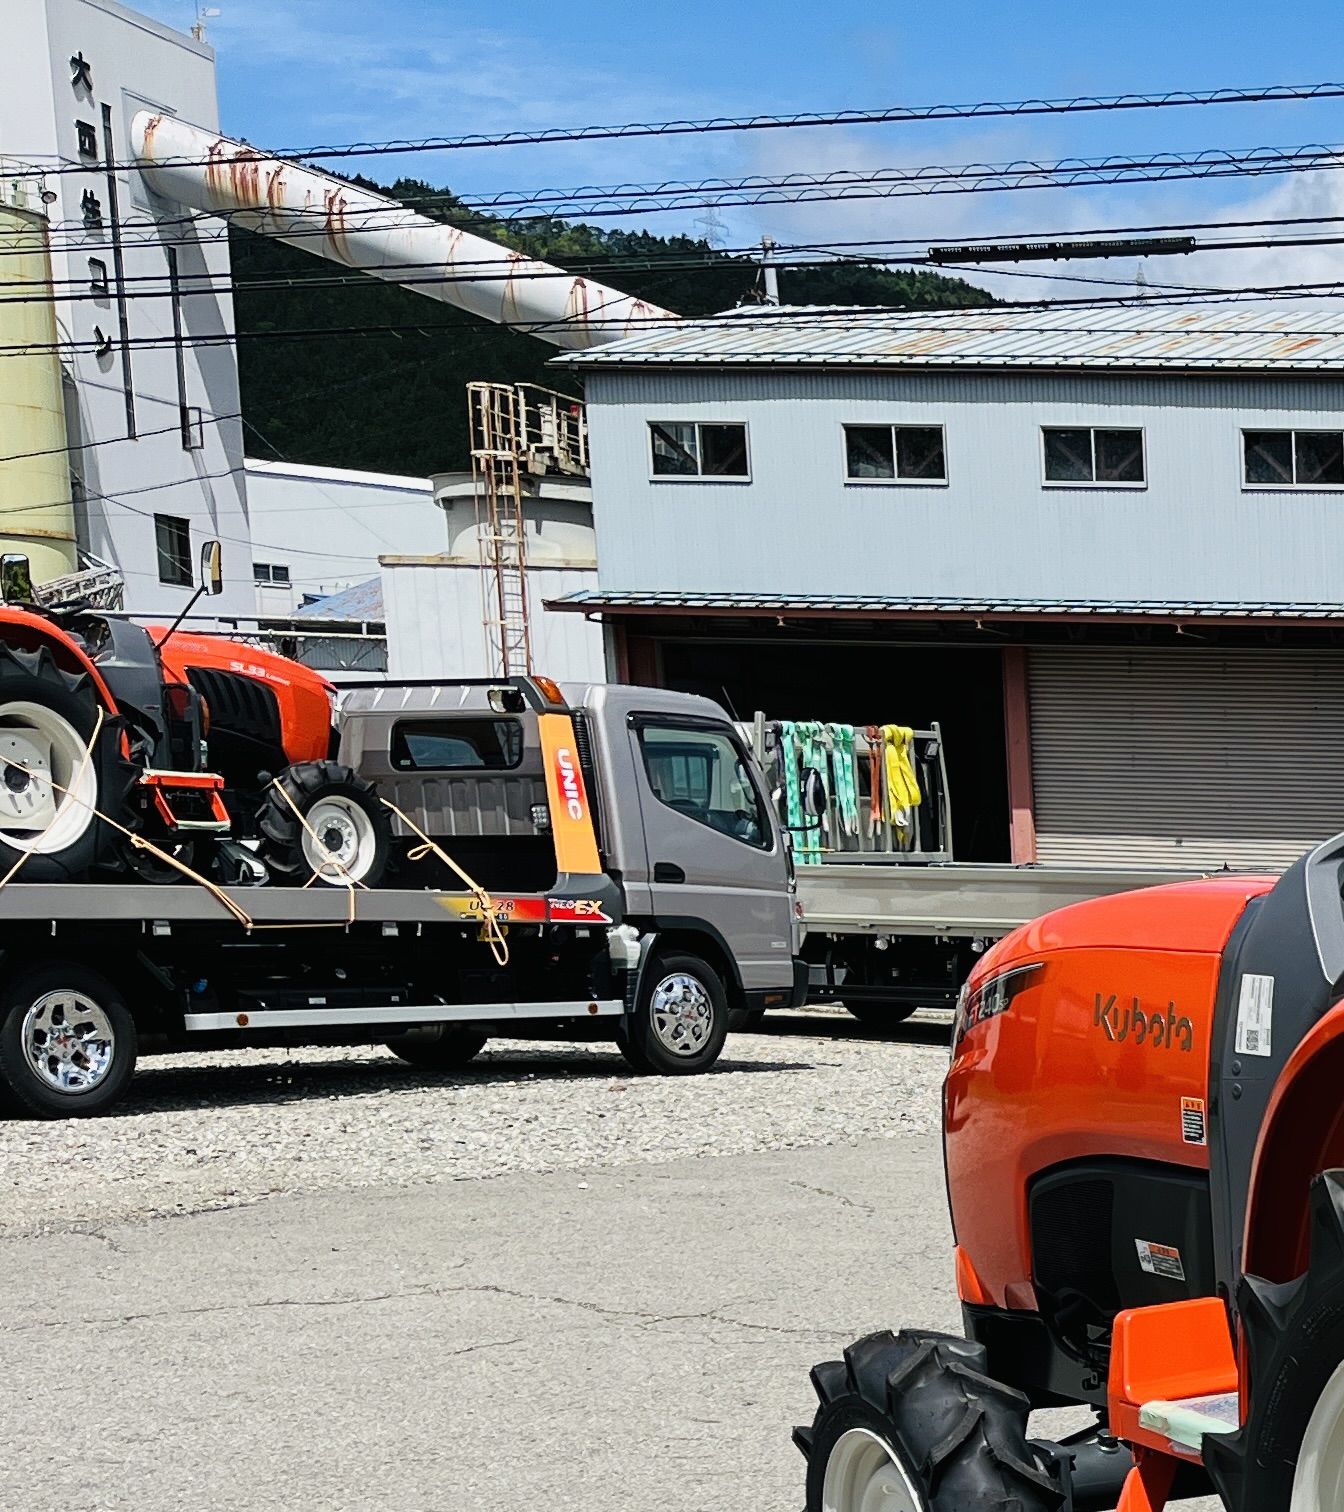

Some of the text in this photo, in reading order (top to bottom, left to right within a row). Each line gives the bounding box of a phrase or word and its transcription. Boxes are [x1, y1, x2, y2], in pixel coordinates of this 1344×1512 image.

[557, 748, 583, 820] UNIC
[575, 900, 603, 914] EX
[1094, 992, 1193, 1052] Kubota
